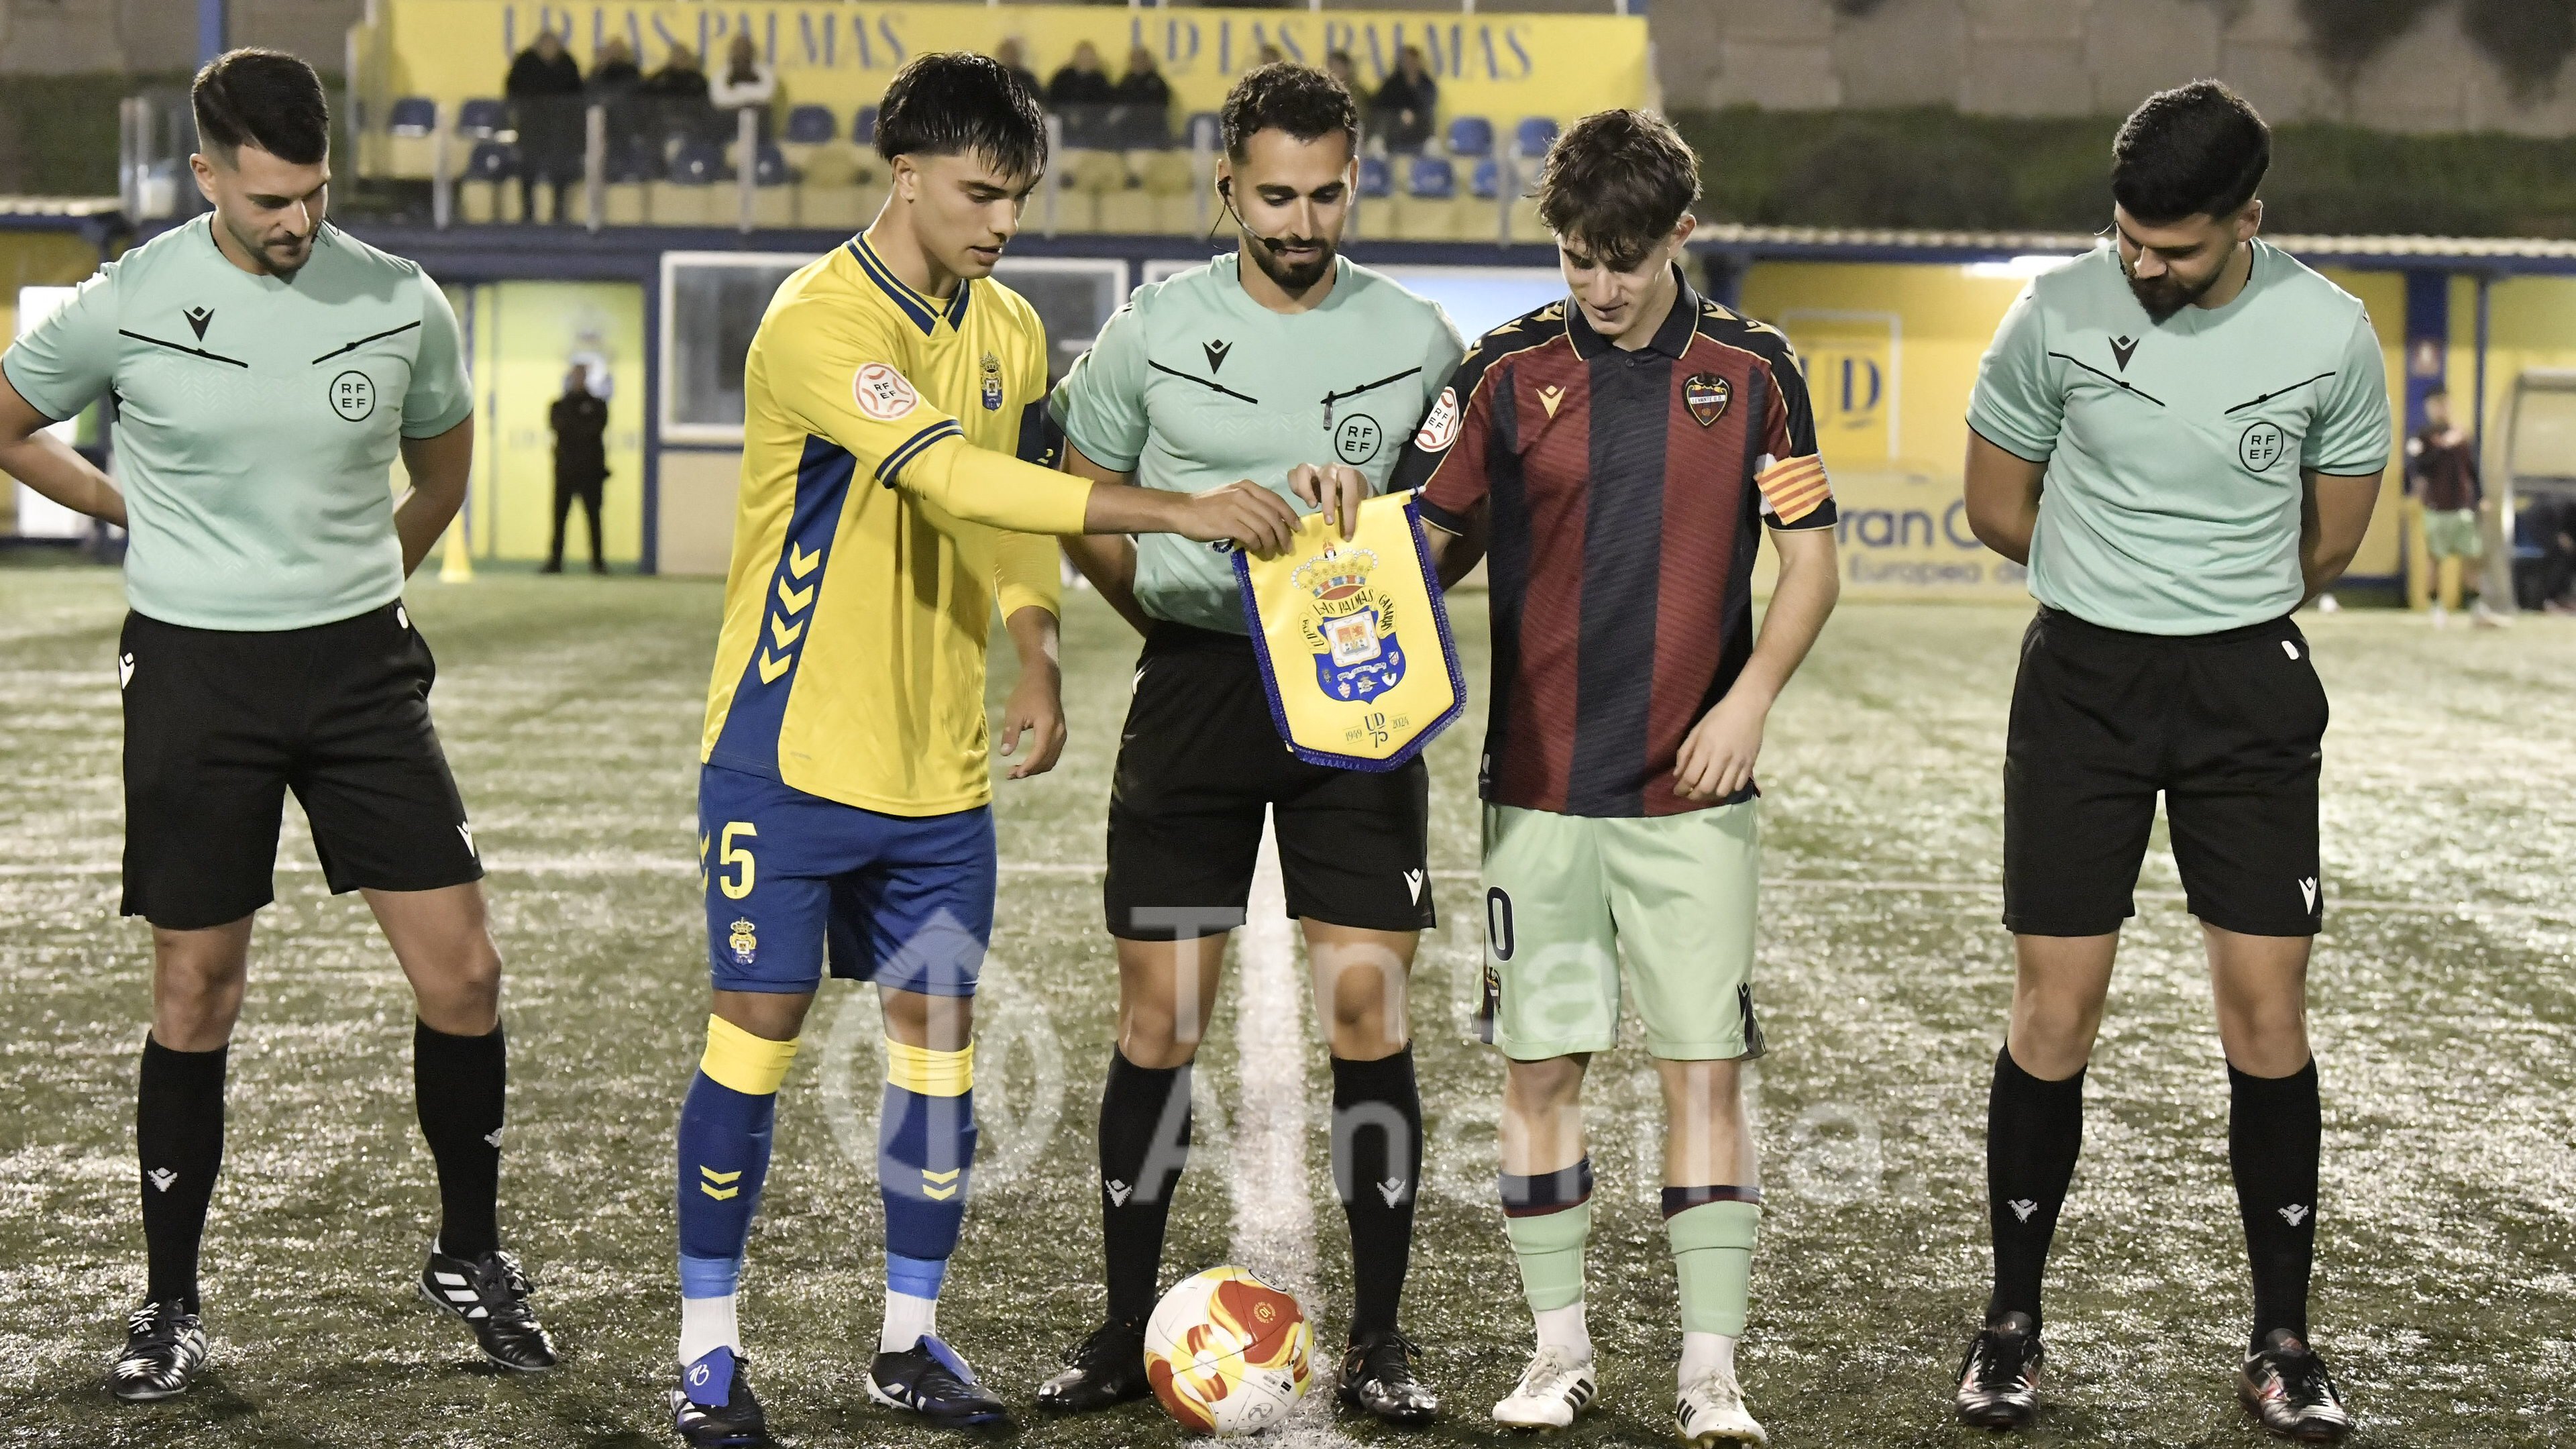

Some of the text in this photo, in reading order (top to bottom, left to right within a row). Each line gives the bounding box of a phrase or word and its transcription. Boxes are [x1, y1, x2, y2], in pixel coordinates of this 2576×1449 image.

[1837, 508, 1934, 549] ran
[1313, 588, 1375, 616] LAS PALMAS
[1364, 712, 1385, 731] UD
[1392, 716, 1409, 729] 2024
[1346, 729, 1362, 741] 1949
[1368, 731, 1389, 749] 75
[720, 821, 757, 900] 5
